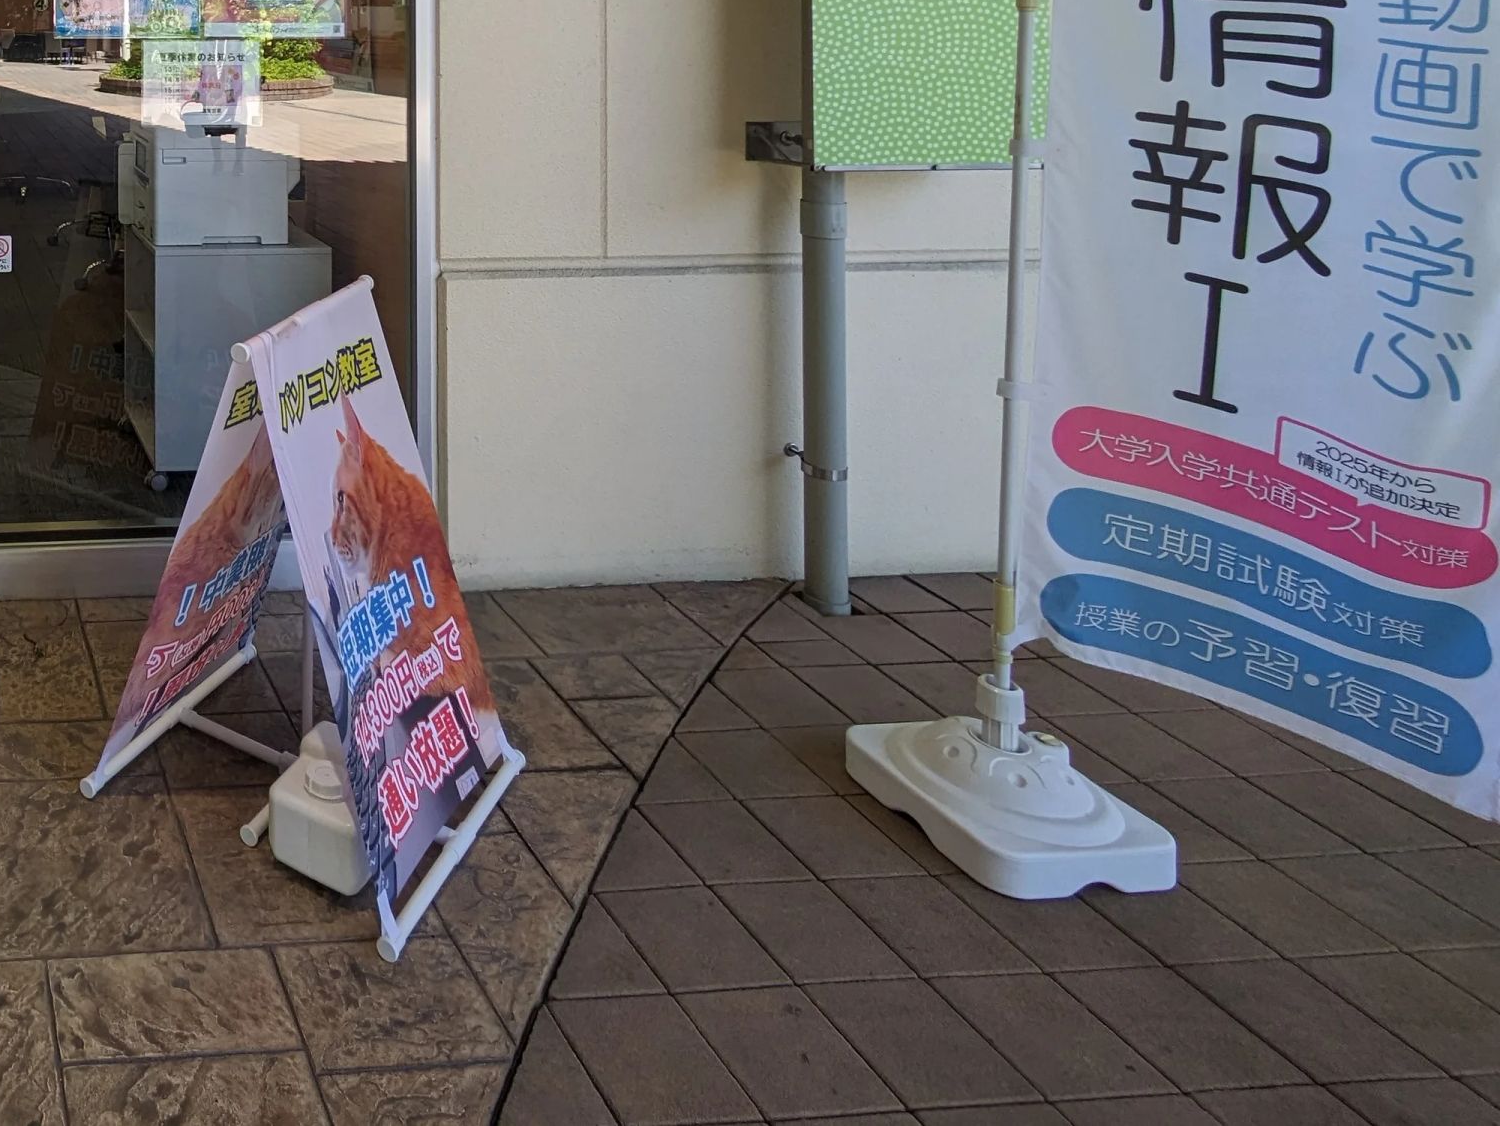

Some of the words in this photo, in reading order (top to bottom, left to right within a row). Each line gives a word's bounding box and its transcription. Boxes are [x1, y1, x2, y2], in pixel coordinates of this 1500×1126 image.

[278, 337, 383, 435] パソコン教室
[1077, 426, 1469, 569] 大学入学共通テスト対策
[1296, 450, 1461, 520] 情報Iが追加決定
[1313, 440, 1437, 495] 2025年から
[336, 556, 437, 696] 短期集中！
[1102, 511, 1426, 650] 定期試験対策
[1074, 601, 1450, 755] 授業の予習・復習
[377, 685, 481, 851] 通い放題！
